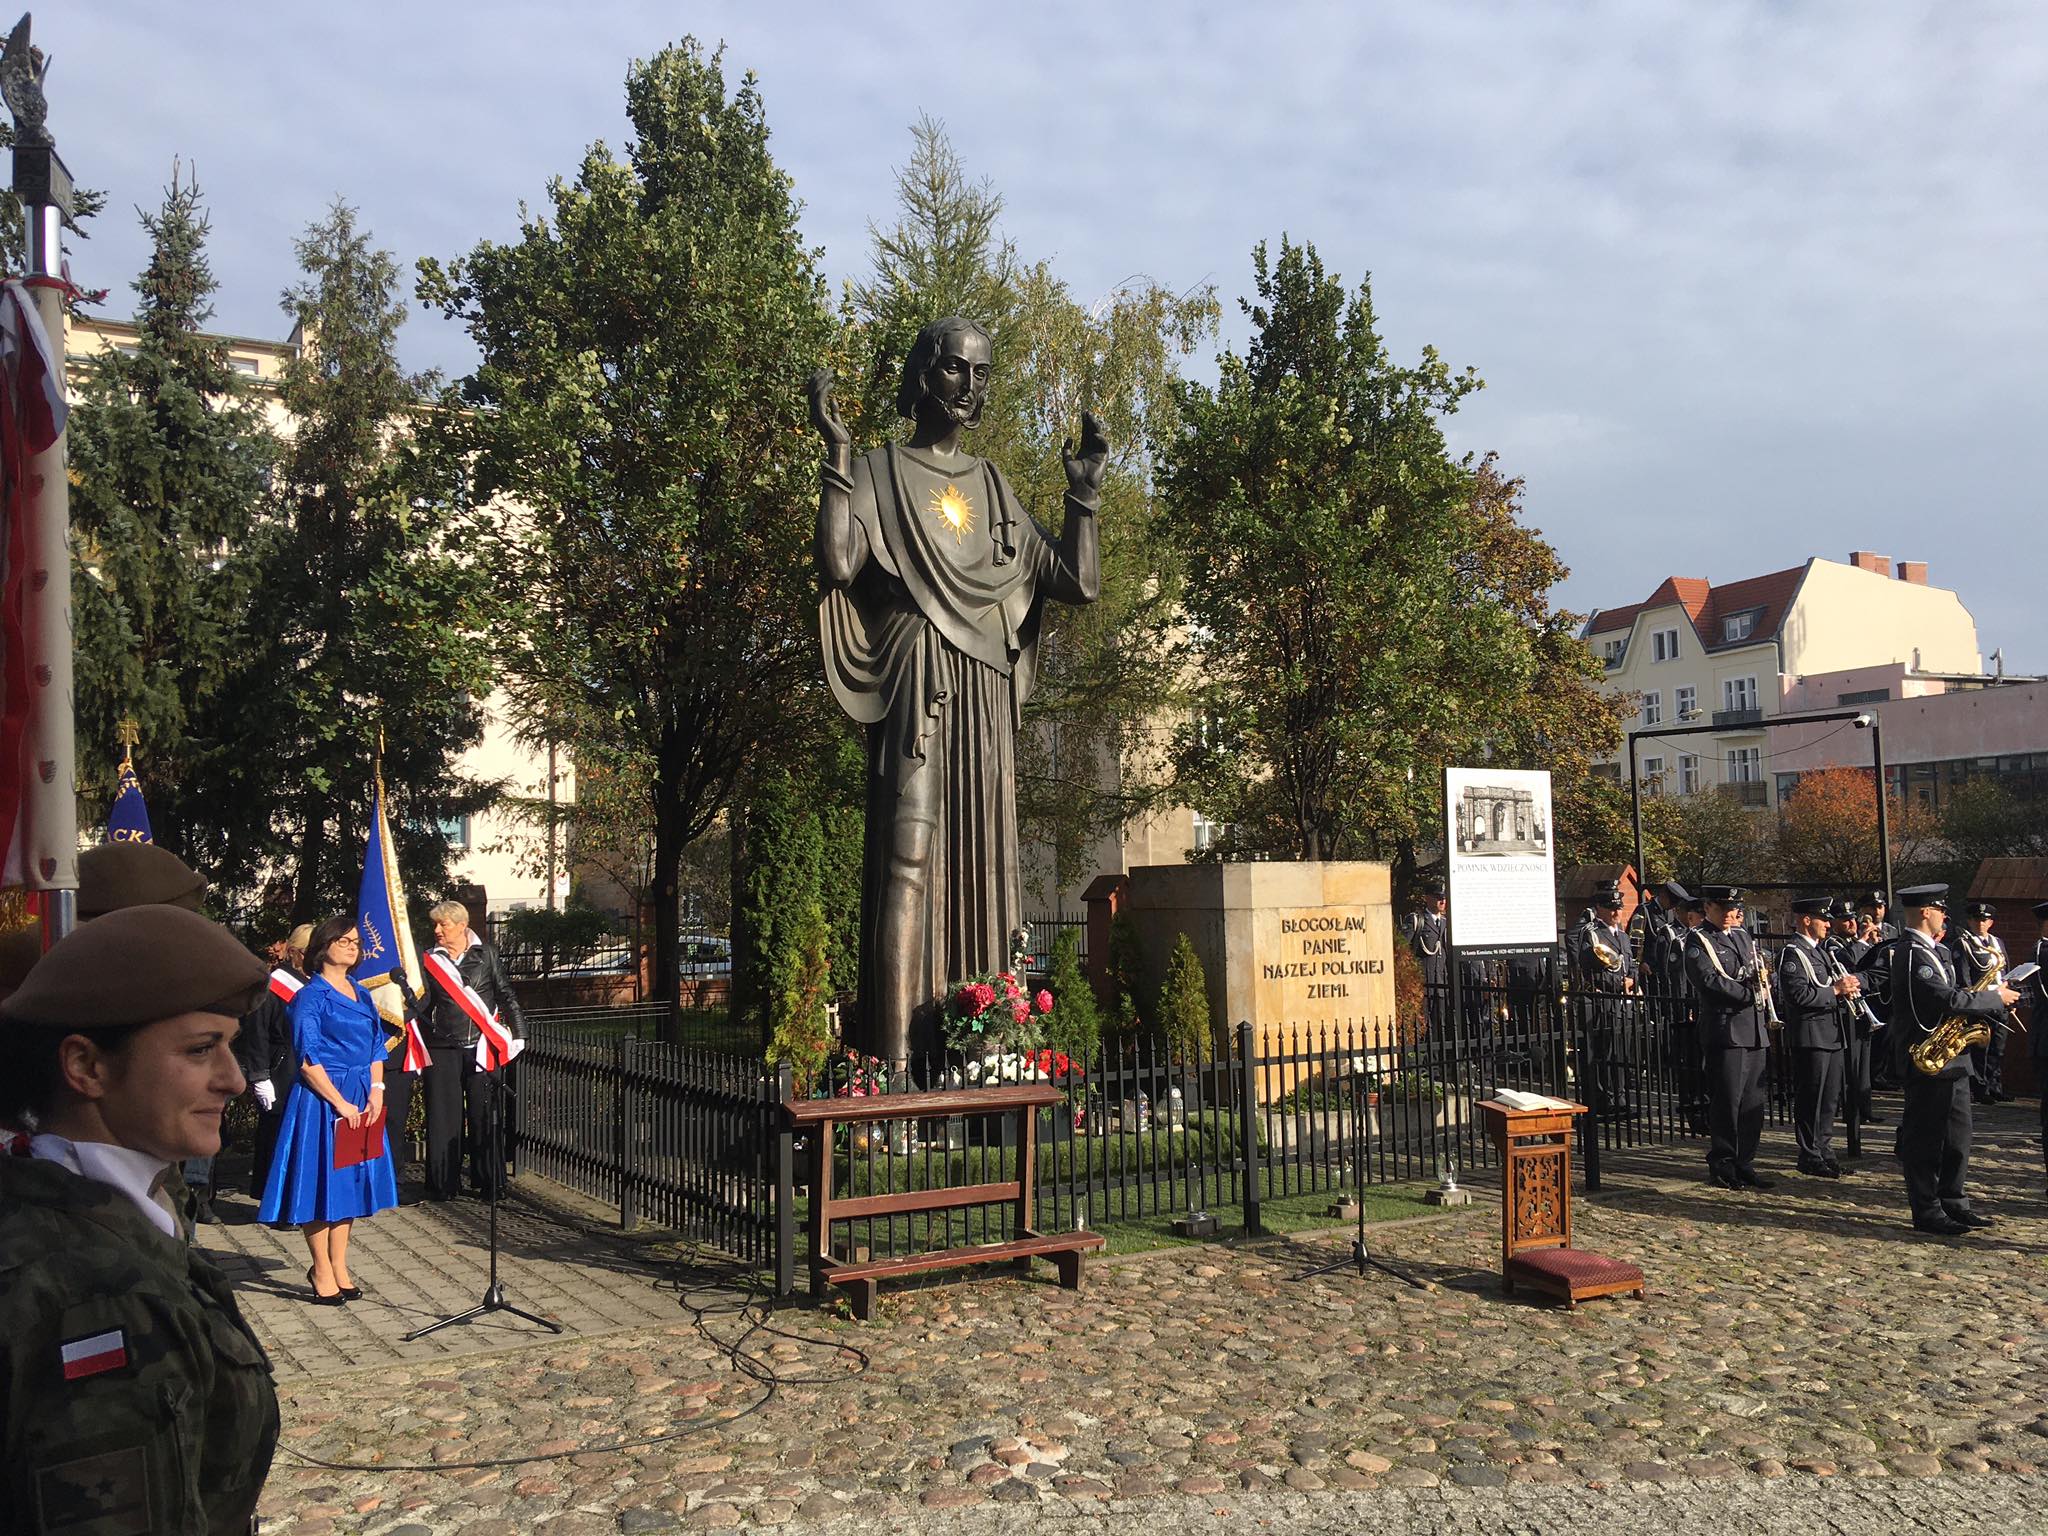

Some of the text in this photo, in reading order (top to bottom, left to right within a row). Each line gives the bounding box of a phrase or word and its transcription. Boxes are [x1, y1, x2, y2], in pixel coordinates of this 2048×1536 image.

[1457, 864, 1488, 872] POMNIK
[1281, 917, 1366, 934] BŁOGOSŁAW,
[1303, 938, 1351, 956] PANIE,
[1263, 960, 1384, 979] NASZEJ POLSKIEJ
[1307, 984, 1349, 999] ZIEMI.
